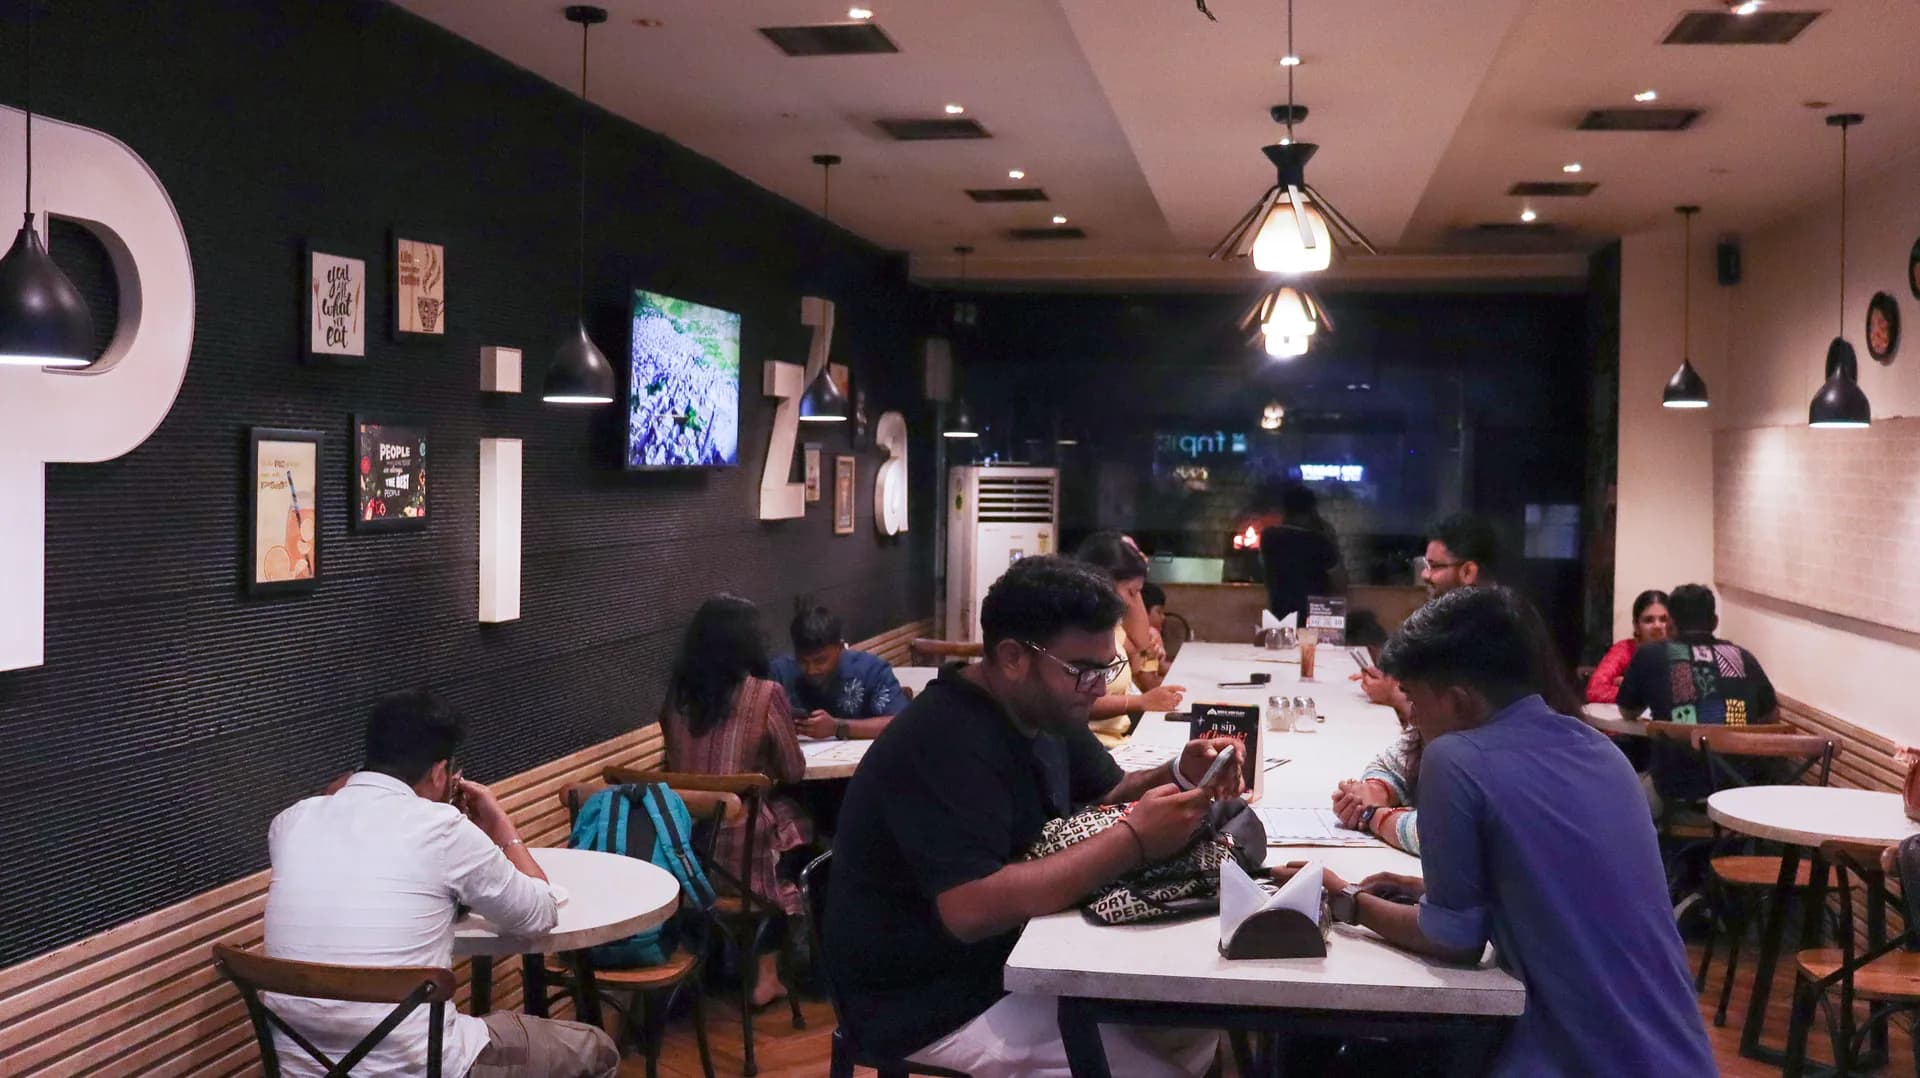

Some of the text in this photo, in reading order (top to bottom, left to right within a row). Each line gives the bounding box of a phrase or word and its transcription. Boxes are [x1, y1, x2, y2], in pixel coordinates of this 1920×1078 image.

[327, 264, 351, 298] you
[322, 292, 352, 317] what
[326, 326, 348, 348] eat
[380, 443, 411, 461] PEOPLE
[385, 473, 410, 490] THE BEST
[384, 489, 400, 498] PEOPLE
[1221, 720, 1236, 735] sip
